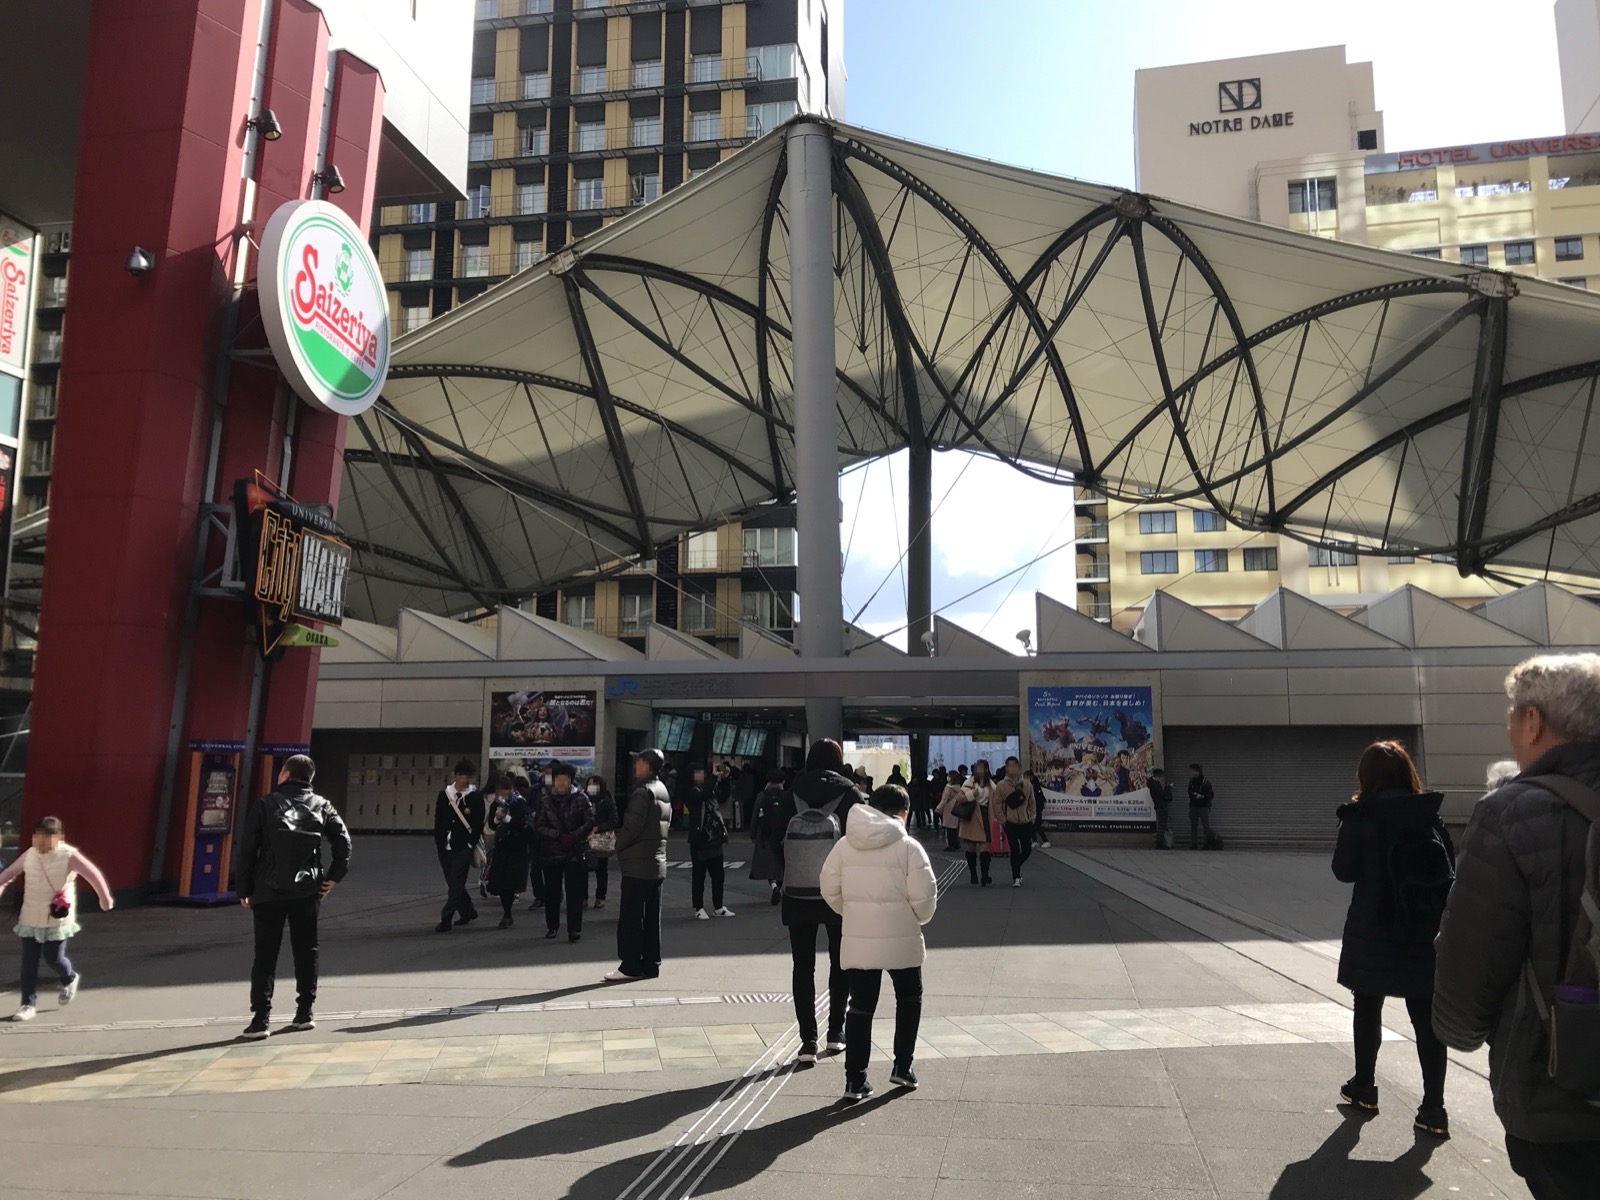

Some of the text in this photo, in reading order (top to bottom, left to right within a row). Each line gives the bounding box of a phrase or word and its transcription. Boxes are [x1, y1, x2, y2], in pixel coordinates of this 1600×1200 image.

[1189, 112, 1294, 136] NOTRE DAME
[1400, 146, 1479, 167] HOTEL
[1, 259, 26, 354] Saizeriya
[290, 243, 378, 361] Saizeriya
[314, 321, 345, 352] RISTORANTE
[292, 505, 337, 534] UNIVERSAL
[299, 535, 347, 618] WALK
[306, 632, 329, 645] OSAKA
[607, 676, 638, 696] JR
